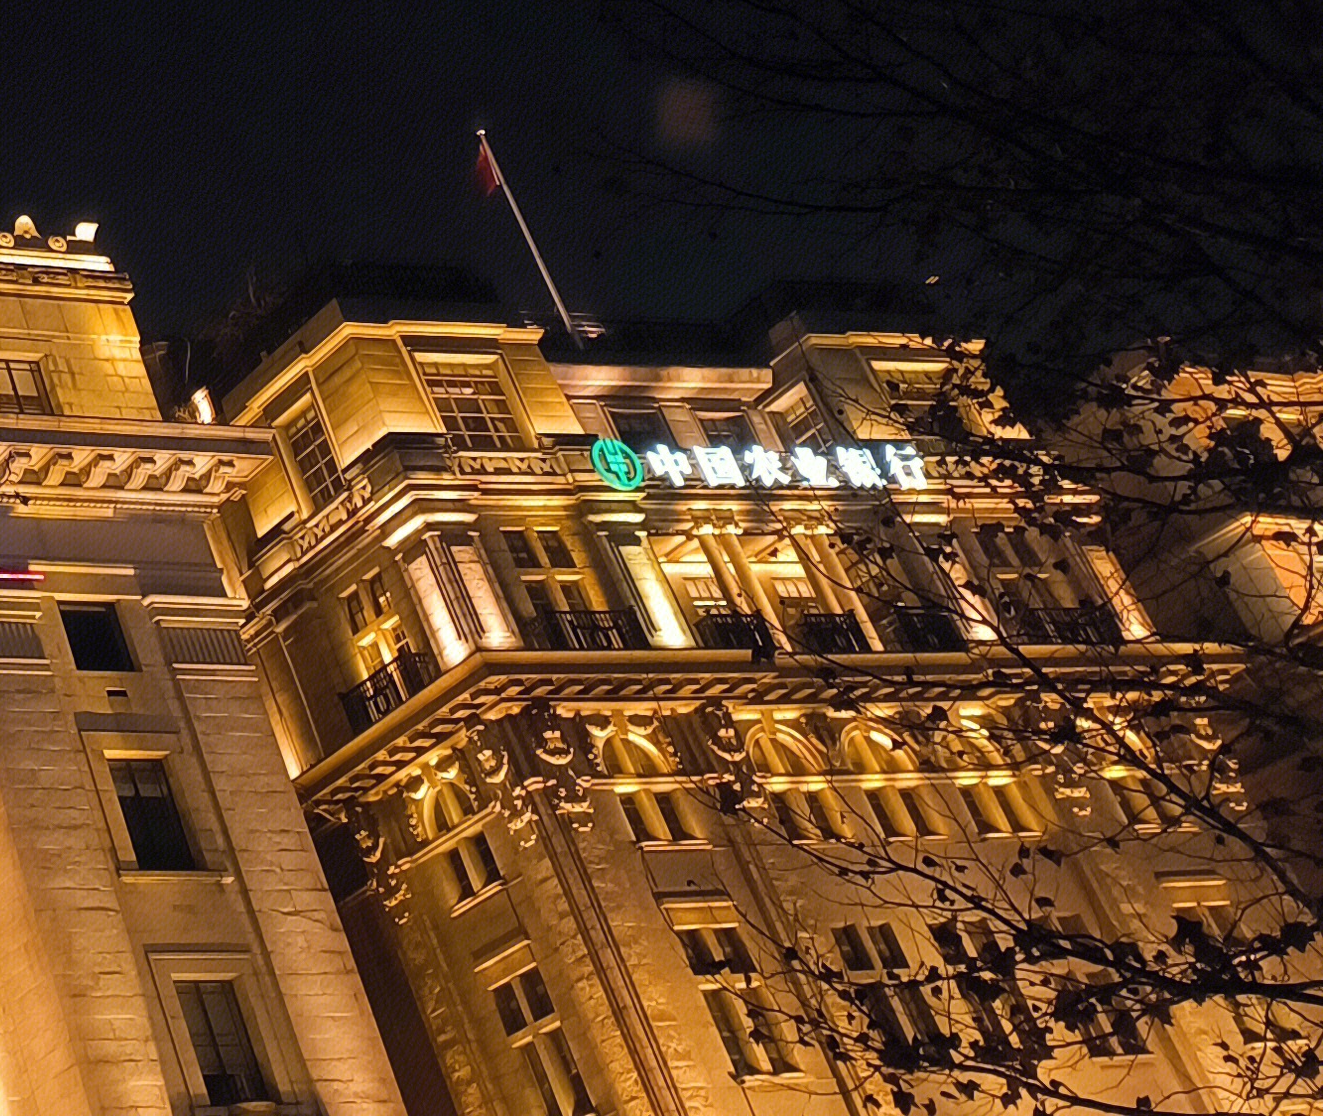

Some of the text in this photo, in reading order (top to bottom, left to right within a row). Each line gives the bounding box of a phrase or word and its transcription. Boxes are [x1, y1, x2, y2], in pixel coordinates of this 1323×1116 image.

[647, 444, 928, 490] 中国农业银行
